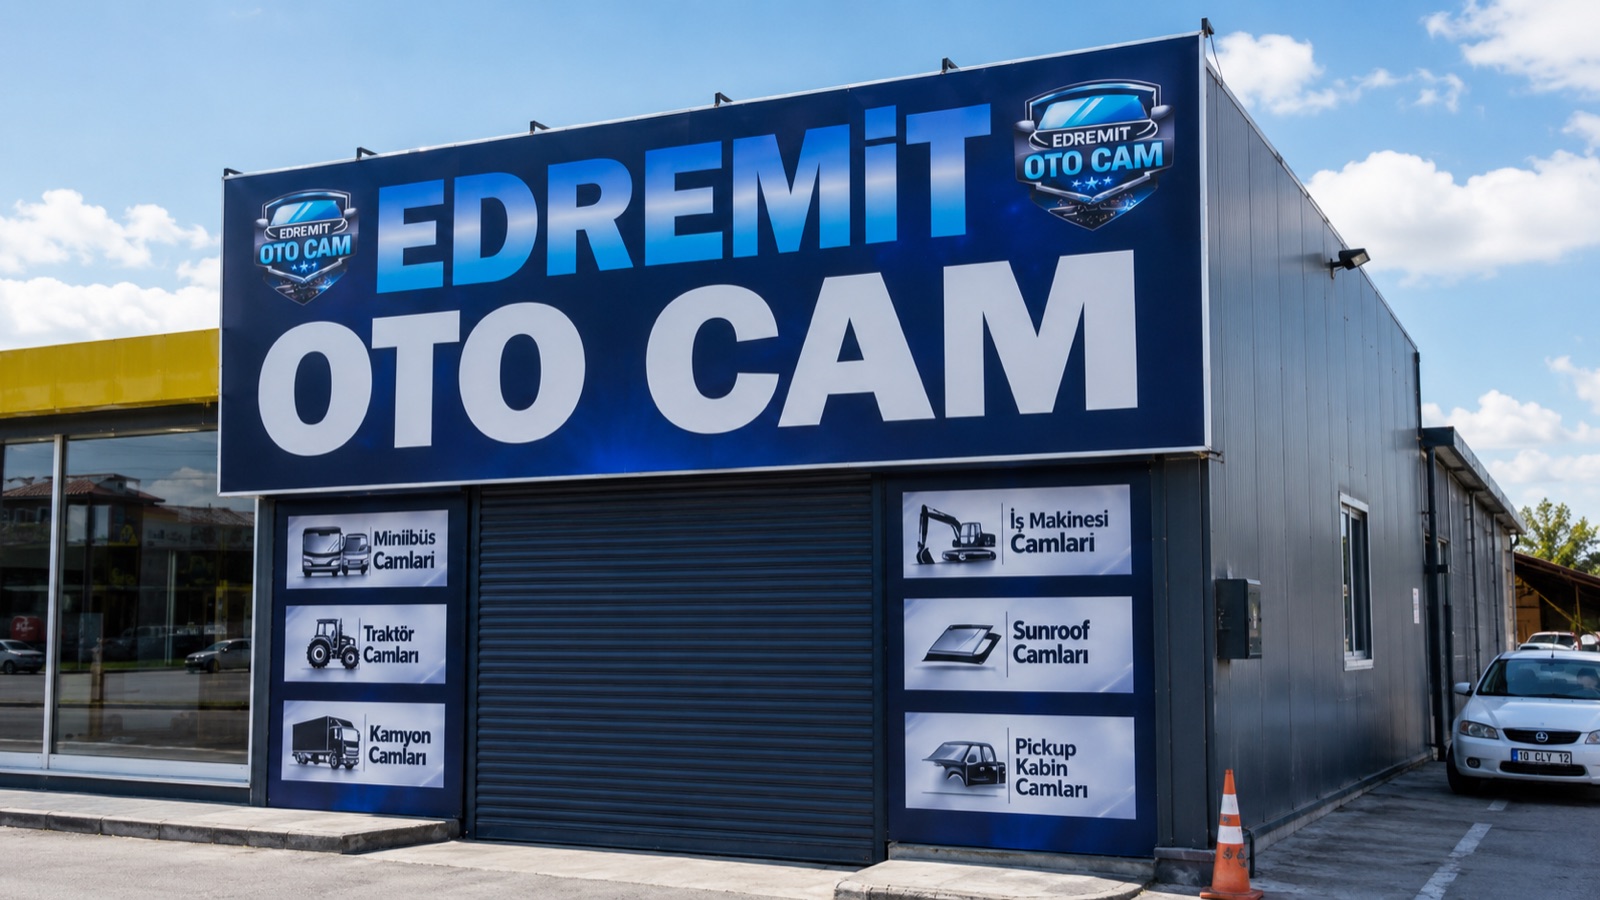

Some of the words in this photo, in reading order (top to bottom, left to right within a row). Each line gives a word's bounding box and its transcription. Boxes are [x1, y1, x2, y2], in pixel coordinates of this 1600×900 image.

[1024, 151, 1083, 180] OTO
[1091, 142, 1164, 173] CAM
[260, 241, 299, 265] OTO
[304, 235, 351, 259] CAM
[258, 302, 586, 456] OTO
[646, 249, 1138, 434] CAM
[1010, 507, 1025, 533] İş
[1029, 509, 1109, 529] Makinesi
[374, 528, 436, 546] Miniibüs
[373, 550, 435, 570] Camlari
[363, 624, 415, 642] Traktör
[1013, 619, 1091, 640] Sunroof
[363, 645, 419, 664] Camları
[1012, 643, 1089, 664] Camları
[369, 724, 432, 748] Kamyon
[368, 745, 427, 766] Camları
[1015, 737, 1077, 761] Pickup
[1519, 751, 1529, 761] 10
[1559, 753, 1570, 764] 12
[1015, 757, 1068, 777] Kabin
[1015, 777, 1089, 799] Camları
